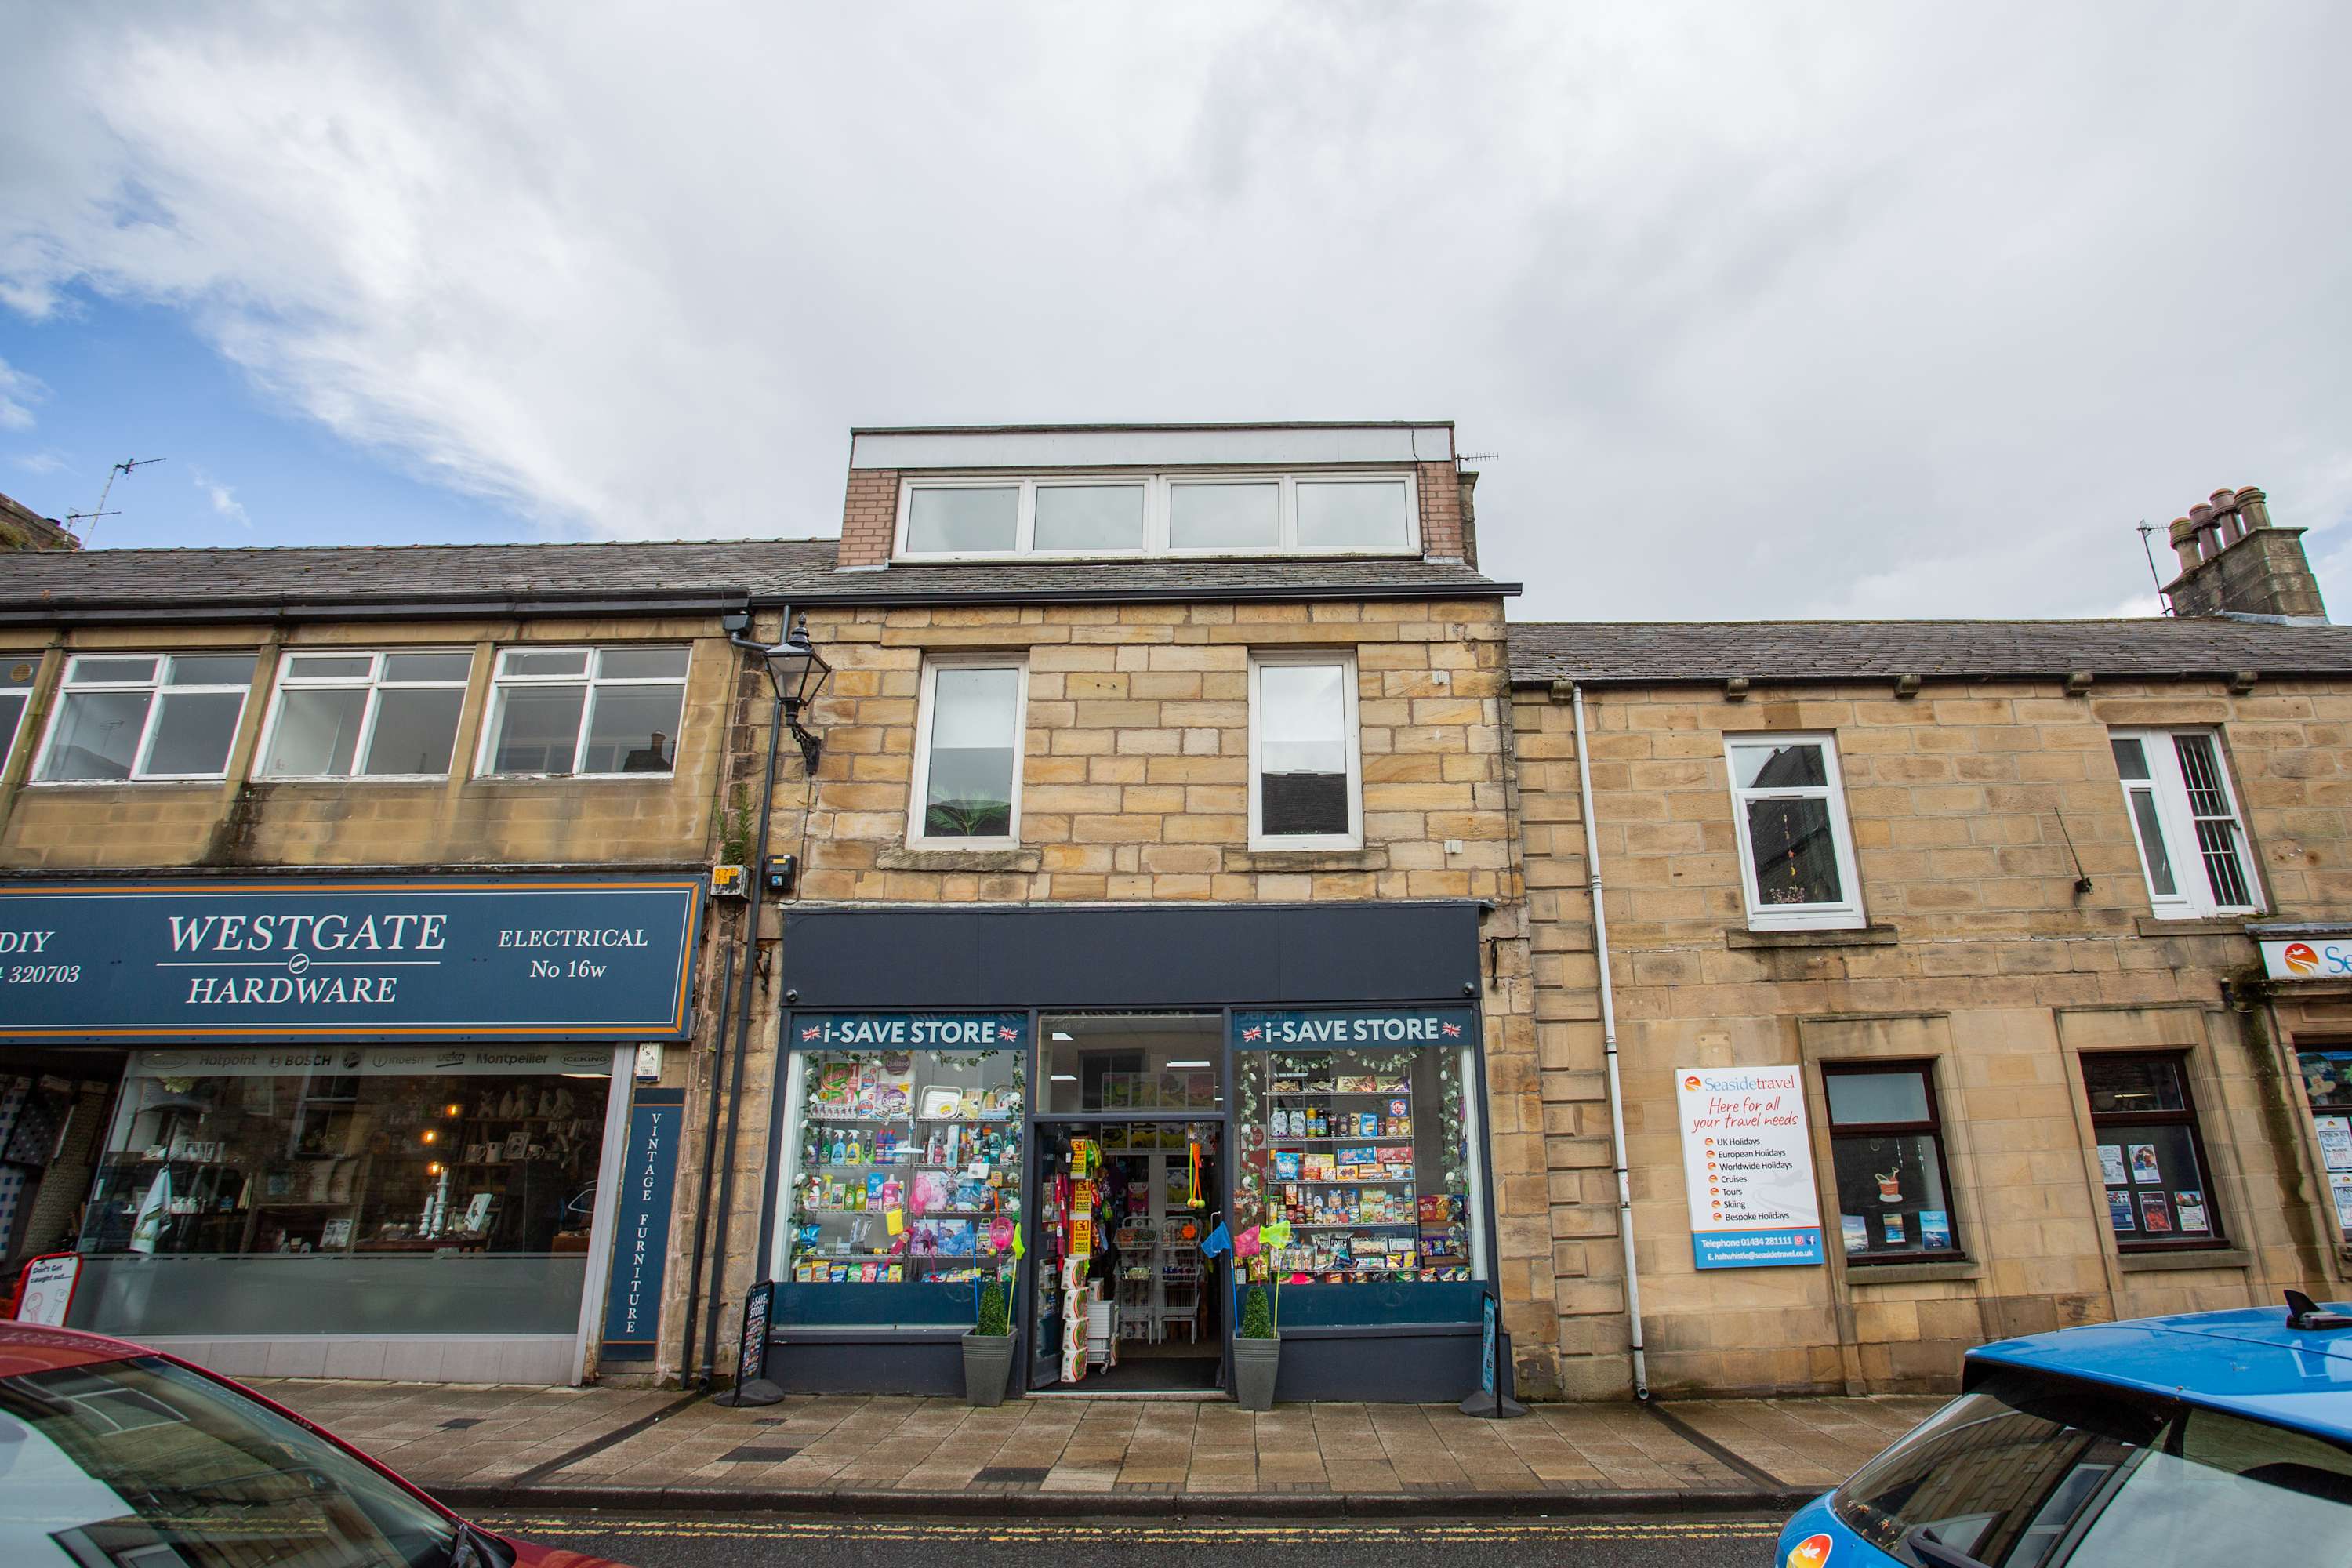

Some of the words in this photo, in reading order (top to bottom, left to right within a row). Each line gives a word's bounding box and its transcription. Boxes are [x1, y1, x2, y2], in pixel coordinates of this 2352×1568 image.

[0, 931, 55, 953] DIY
[169, 914, 447, 952] WESTGATE
[498, 929, 649, 947] ELECTRICAL
[9, 965, 81, 983] 320703
[530, 960, 560, 978] No
[568, 960, 607, 978] 16w
[185, 977, 398, 1004] HARDWARE
[824, 1022, 905, 1044] i-SAVE
[910, 1022, 995, 1044] STORE
[1265, 1020, 1348, 1043] i-SAVE
[1353, 1018, 1439, 1041] STORE
[199, 1054, 258, 1067] Hotpoint
[285, 1055, 332, 1066] BOSCH
[476, 1053, 549, 1066] Montpellier
[1704, 1075, 1795, 1091] Seasidetravel
[1709, 1097, 1739, 1115] Here
[1743, 1096, 1762, 1113] for
[1766, 1096, 1780, 1111] all
[1691, 1118, 1720, 1134] your
[1725, 1112, 1762, 1129] travel
[1764, 1111, 1798, 1126] needs
[642, 1113, 662, 1201] VINTAGE
[1718, 1150, 1754, 1159] European
[1755, 1149, 1786, 1158] Holidays
[1719, 1162, 1760, 1171] Worldwide
[1762, 1160, 1793, 1169] Holidays
[1077, 1181, 1090, 1190] £1
[1724, 1200, 1746, 1209] Skiing
[1076, 1221, 1088, 1230] £1
[1726, 1213, 1756, 1221] Bespoke
[1701, 1239, 1740, 1248] Telephone
[1765, 1236, 1792, 1245] 281111
[626, 1214, 649, 1333] FURNITURE
